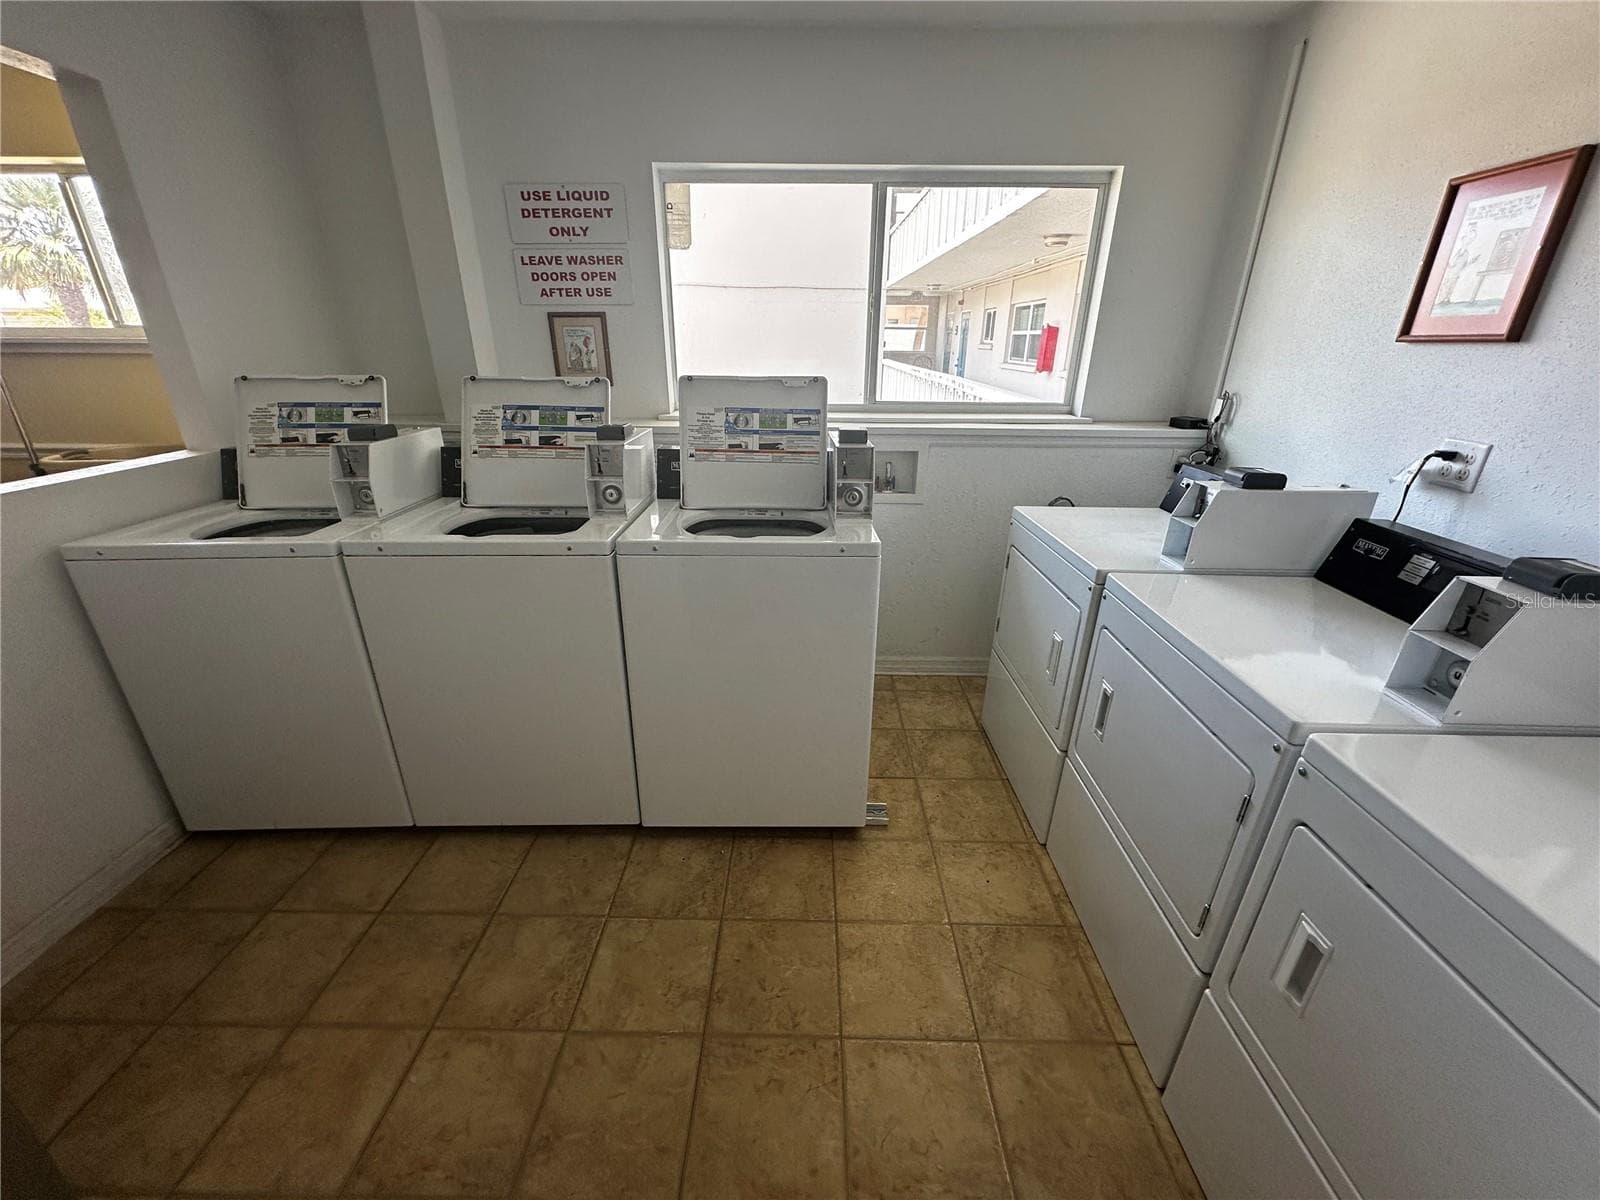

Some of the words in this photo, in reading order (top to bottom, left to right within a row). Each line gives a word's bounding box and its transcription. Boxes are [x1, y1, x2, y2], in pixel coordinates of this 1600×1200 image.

[520, 191, 552, 201] USE
[556, 190, 609, 202] LIQUID
[521, 208, 613, 219] DETERGENT
[549, 226, 589, 237] ONLY
[520, 256, 563, 266] LEAVE
[566, 255, 624, 265] WASHER
[531, 272, 577, 282] DOORS
[581, 272, 616, 281] OPEN
[540, 288, 582, 299] AFTER
[586, 288, 612, 297] USE
